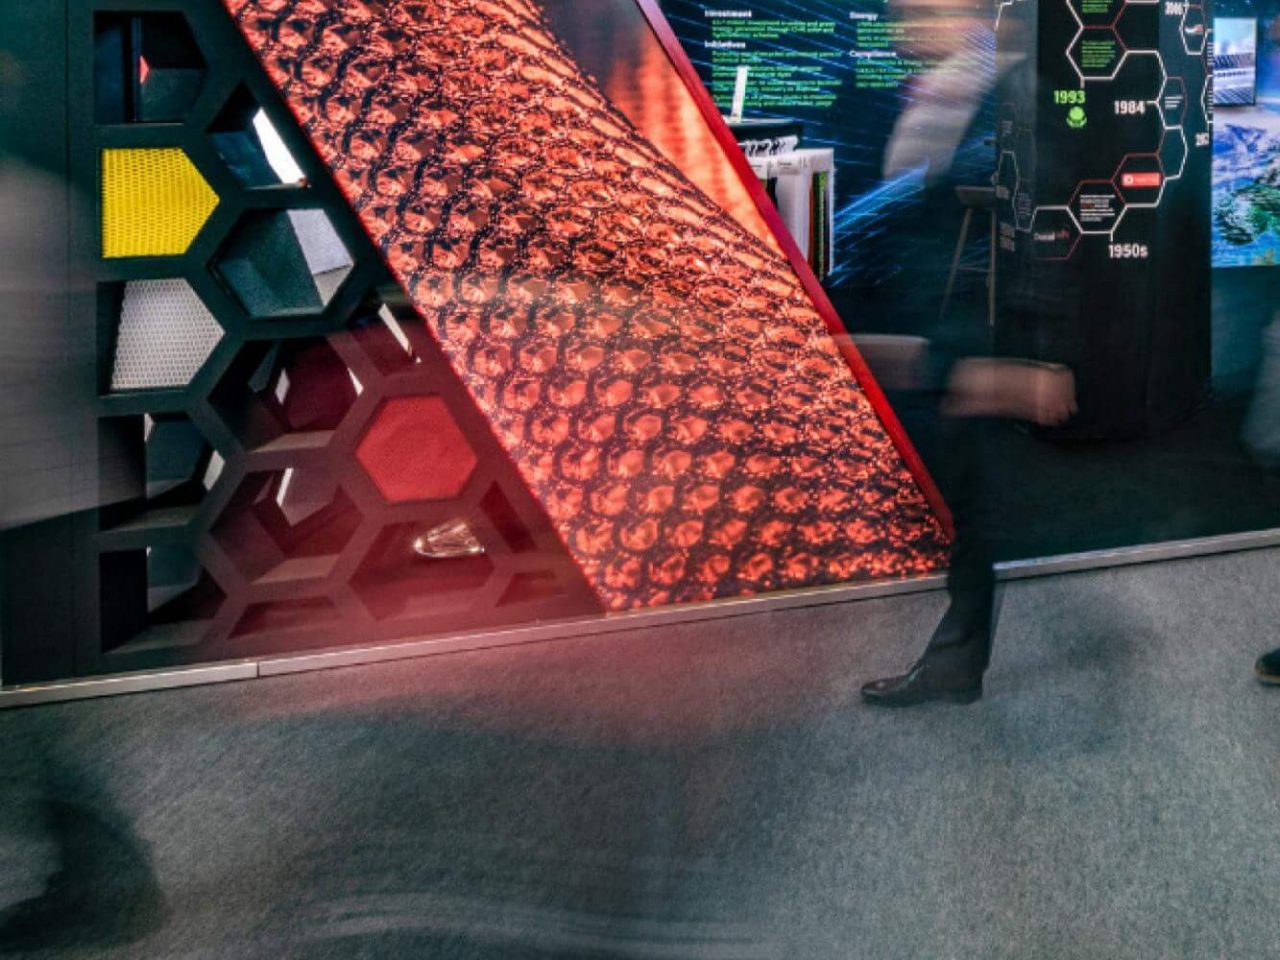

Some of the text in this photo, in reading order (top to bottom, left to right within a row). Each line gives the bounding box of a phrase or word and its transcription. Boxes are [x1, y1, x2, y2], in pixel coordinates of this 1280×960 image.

[1054, 90, 1086, 104] 1993
[1114, 100, 1146, 115] 1984
[1108, 244, 1148, 259] 1950s
